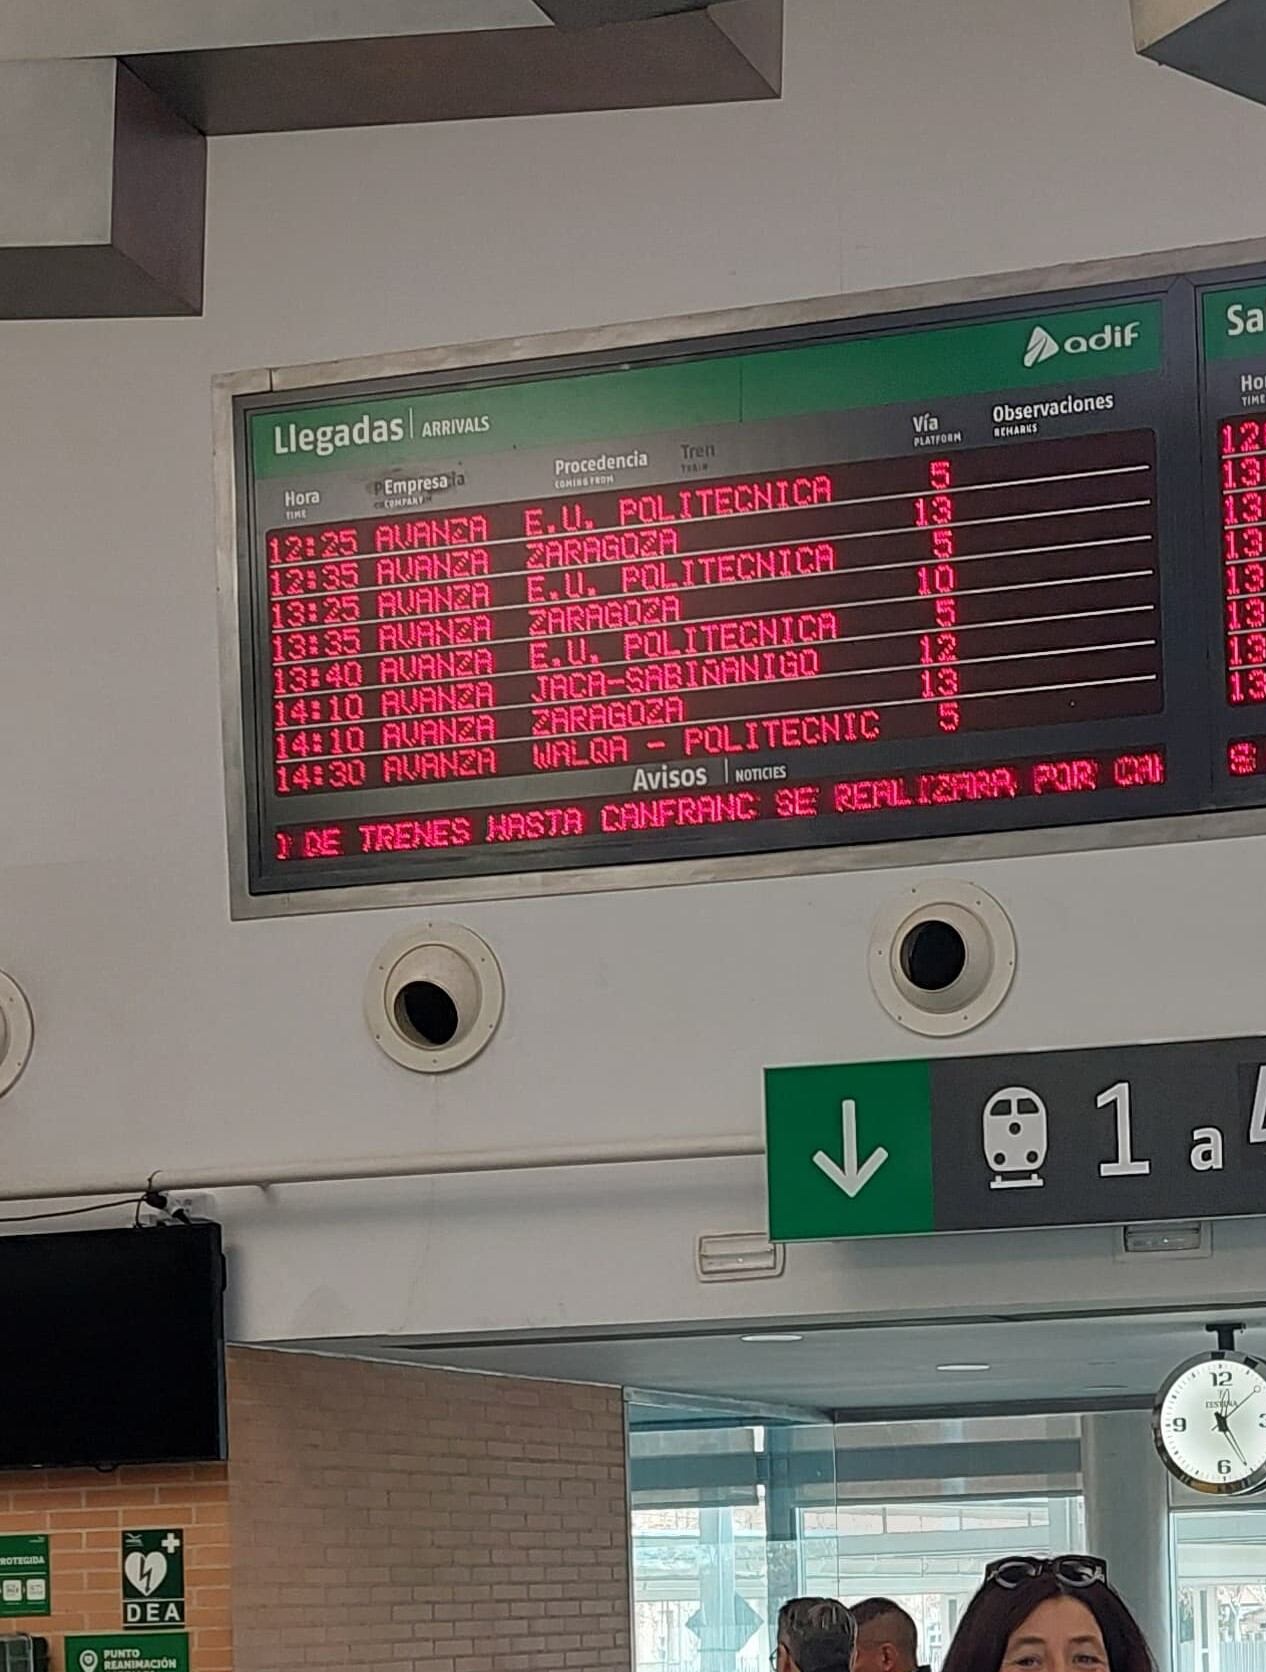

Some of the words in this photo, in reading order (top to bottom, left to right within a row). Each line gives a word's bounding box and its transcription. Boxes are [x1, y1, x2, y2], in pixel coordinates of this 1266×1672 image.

[1063, 321, 1141, 354] adif
[274, 414, 405, 456] Llegadas
[421, 415, 490, 438] ARRIVALS
[1241, 394, 1266, 406] TIME
[284, 489, 321, 508] Hora
[384, 475, 448, 495] Empresa
[554, 450, 649, 475] Procedencia
[912, 412, 939, 433] Vía
[992, 393, 1115, 423] Observaciones
[285, 509, 307, 521] TIME
[913, 431, 962, 447] PLATFORM
[268, 529, 359, 564] 12:25
[374, 515, 488, 553] AVANZA
[523, 503, 597, 538] E.U.
[618, 474, 834, 527] POLITECNICA
[929, 460, 951, 490] 5
[269, 561, 360, 597] 12:35
[376, 548, 490, 586] AVANZA
[525, 527, 680, 570] ZARAGOZA
[914, 494, 952, 528] 13
[271, 594, 361, 630] 13:25
[377, 581, 491, 618] AVANZA
[526, 571, 598, 604] E.U.
[620, 543, 836, 593] POLITECNICA
[933, 529, 953, 559] 5
[272, 627, 362, 662] 13:35
[378, 614, 492, 651] AVANZA
[527, 594, 681, 638] ZARAGOZA
[916, 563, 955, 597] 10
[274, 660, 363, 695] 13:40
[379, 648, 493, 684] AVANZA
[528, 637, 600, 671] E.U.
[623, 611, 840, 662] POLITECNICA
[935, 597, 957, 629] 5
[274, 693, 364, 728] 14:10
[380, 681, 495, 718] AVANZA
[918, 631, 958, 665] 12
[275, 725, 366, 761] 14:10
[381, 714, 496, 750] AVANZA
[531, 695, 686, 737] ZARAGOZA
[920, 666, 959, 700] 13
[276, 758, 367, 793] 14:30
[382, 746, 497, 784] AVANZA
[531, 735, 630, 770] WALQA
[683, 710, 882, 758] POLITECNIC
[937, 699, 961, 733] 5
[303, 827, 344, 858] DE
[358, 816, 472, 853] TRENES
[601, 791, 760, 834] CANFRANC
[772, 785, 821, 817] SE
[1031, 757, 1102, 797] POR
[632, 764, 708, 793] Avisos
[735, 764, 788, 782] NOTICIES
[1096, 1082, 1150, 1177] 1
[1190, 1126, 1223, 1171] a
[1210, 1371, 1233, 1387] 12
[1172, 1417, 1187, 1432] 9
[1217, 1459, 1231, 1475] 6
[0, 1556, 46, 1566] ROTEGIDA
[103, 1649, 140, 1659] PUNTO
[126, 1603, 182, 1622] DEA
[103, 1657, 177, 1671] REANIMACIÓN
